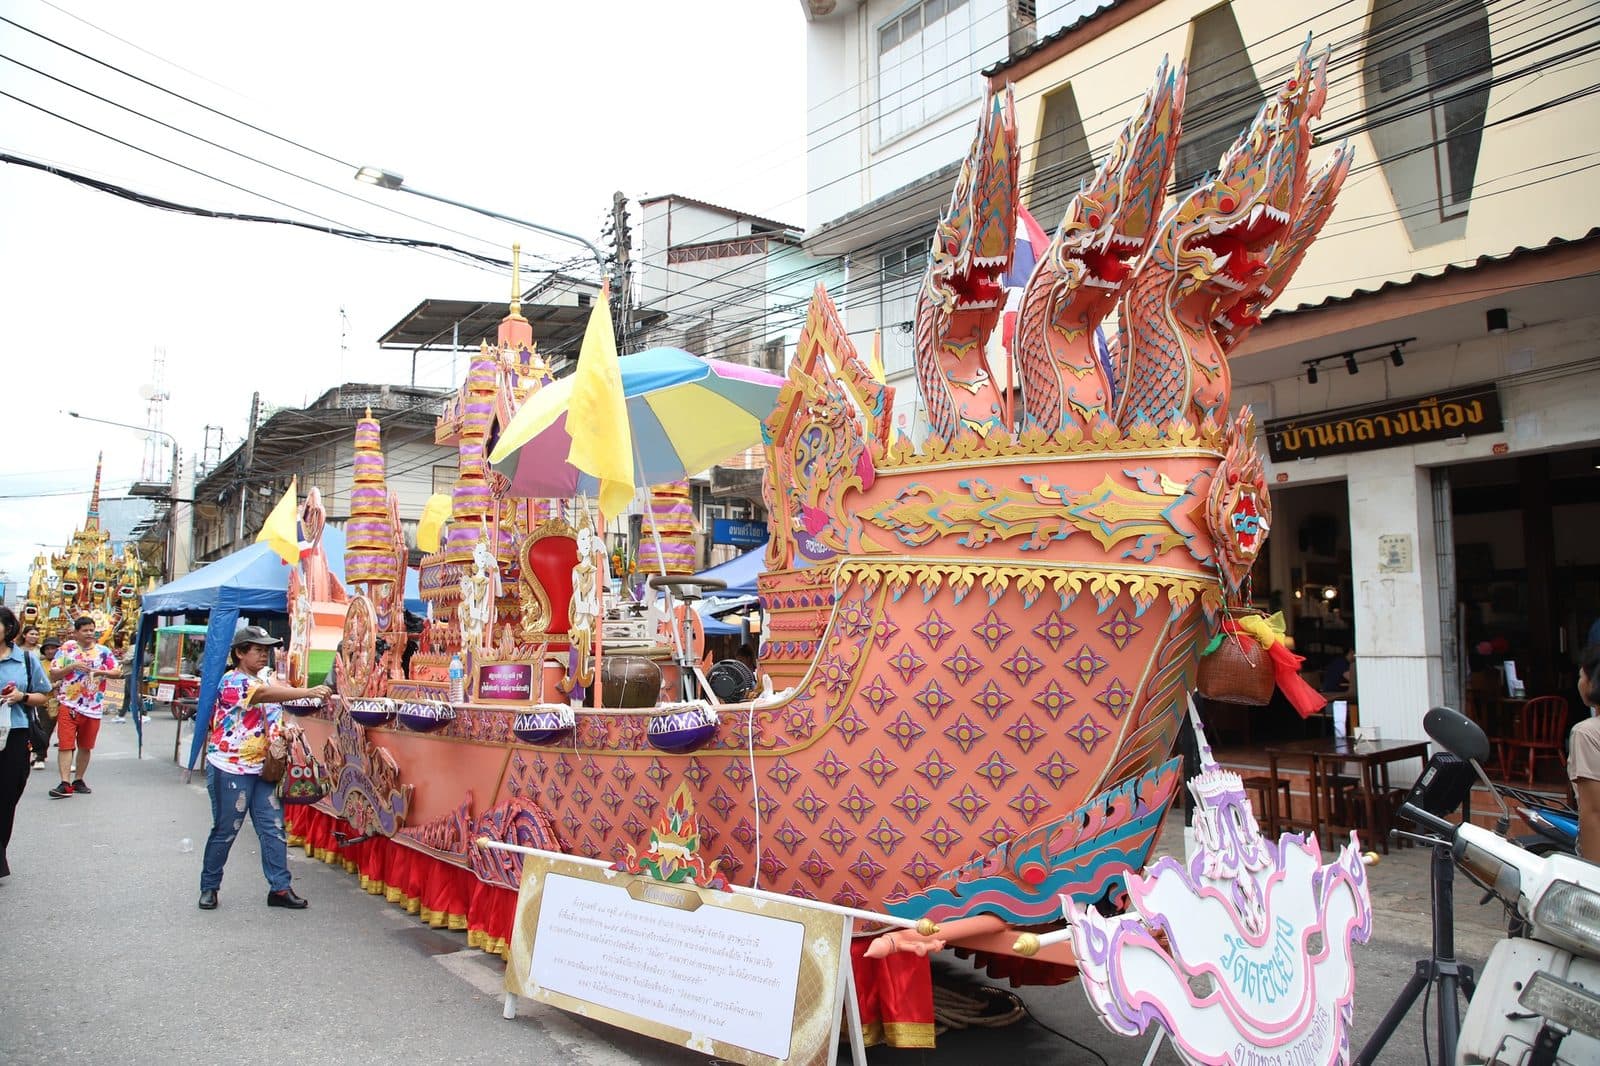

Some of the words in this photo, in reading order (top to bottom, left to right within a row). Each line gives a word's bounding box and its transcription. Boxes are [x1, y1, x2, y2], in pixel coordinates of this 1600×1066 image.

[1282, 396, 1485, 451] บ้านกลางเมือง
